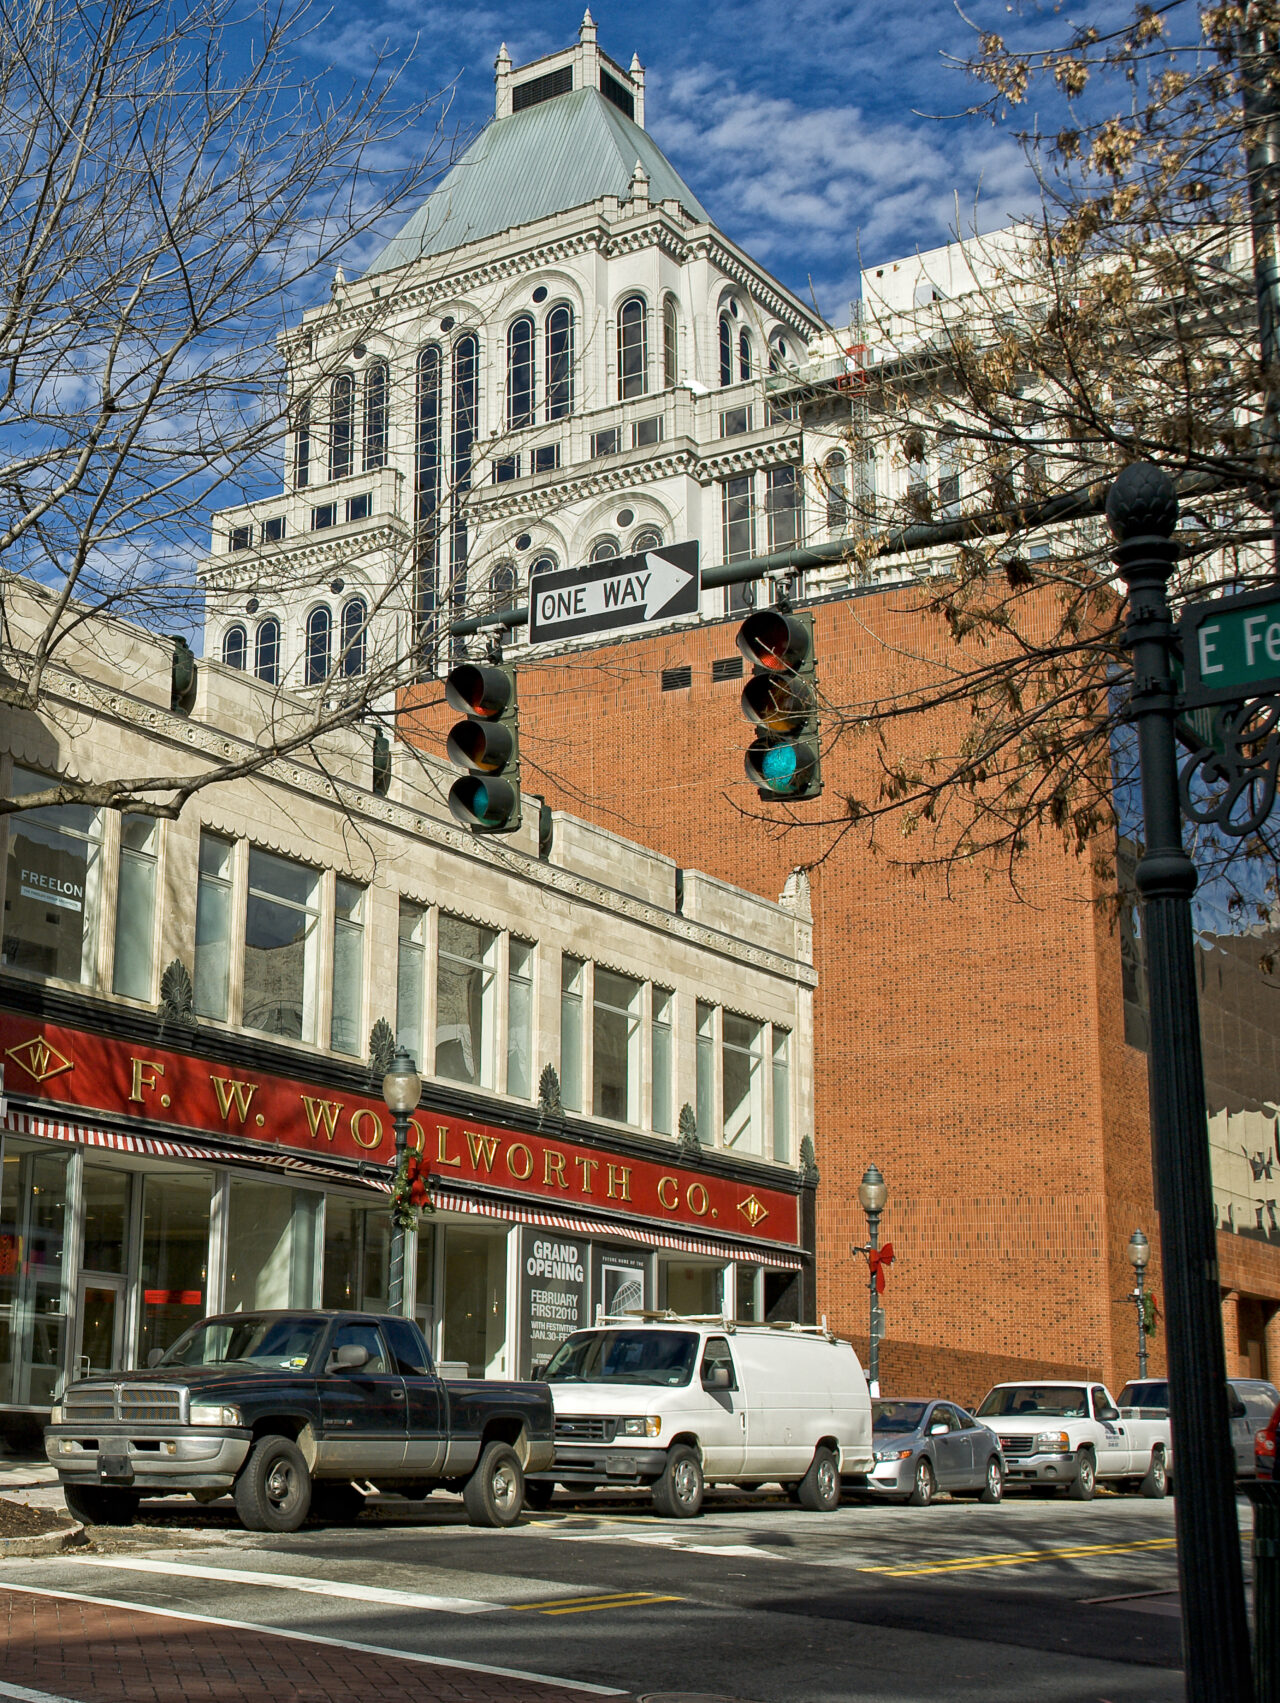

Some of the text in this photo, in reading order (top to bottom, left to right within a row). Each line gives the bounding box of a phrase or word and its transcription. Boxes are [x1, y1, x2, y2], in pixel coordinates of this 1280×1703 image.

[542, 572, 653, 621] ONE WAY
[1198, 624, 1224, 675] E
[21, 869, 83, 898] FREELON
[29, 1042, 51, 1075] W
[128, 1057, 171, 1108] F.
[209, 1075, 265, 1127] W.
[657, 1176, 718, 1219] CO.
[533, 1240, 578, 1263] GRAND
[526, 1258, 584, 1282] OPENING
[531, 1289, 578, 1307] FEBRUARY
[531, 1303, 578, 1321] FIRST2010
[531, 1320, 578, 1332] WITH FESTIVITIES
